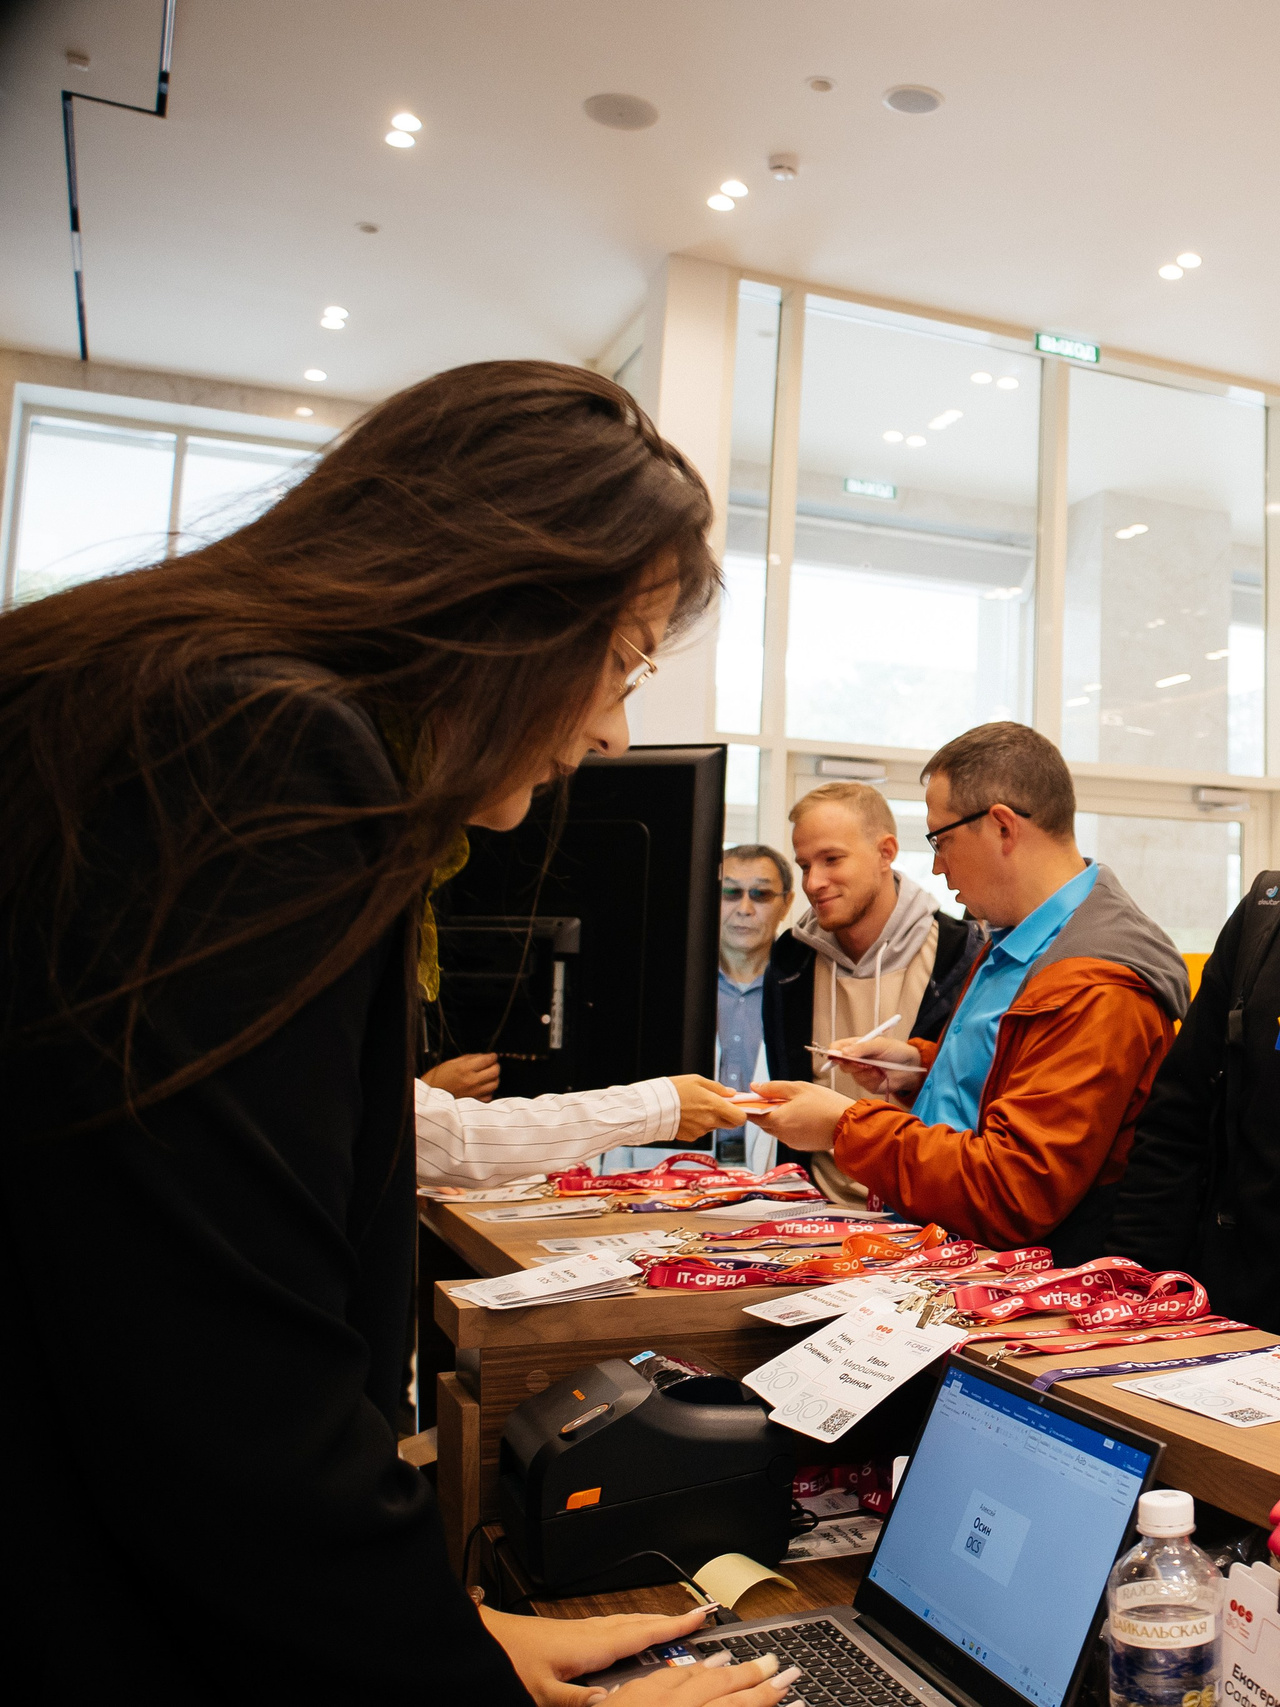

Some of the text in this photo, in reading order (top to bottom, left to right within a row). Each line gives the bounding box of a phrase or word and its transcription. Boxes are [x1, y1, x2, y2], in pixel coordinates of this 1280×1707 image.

[1039, 335, 1097, 362] ВЫХОД
[700, 1177, 738, 1186] СРЕДА
[847, 1224, 874, 1233] OCS
[941, 1243, 969, 1258] OCS
[833, 1260, 859, 1271] OCS
[676, 1271, 747, 1287] IT-СРЕДА
[991, 1297, 1024, 1316] OCS
[866, 1355, 890, 1369] Иван
[973, 1516, 992, 1537] Осин
[966, 1536, 981, 1554] OCS
[1113, 1615, 1208, 1638] БАЙКАЛЬСКАЯ
